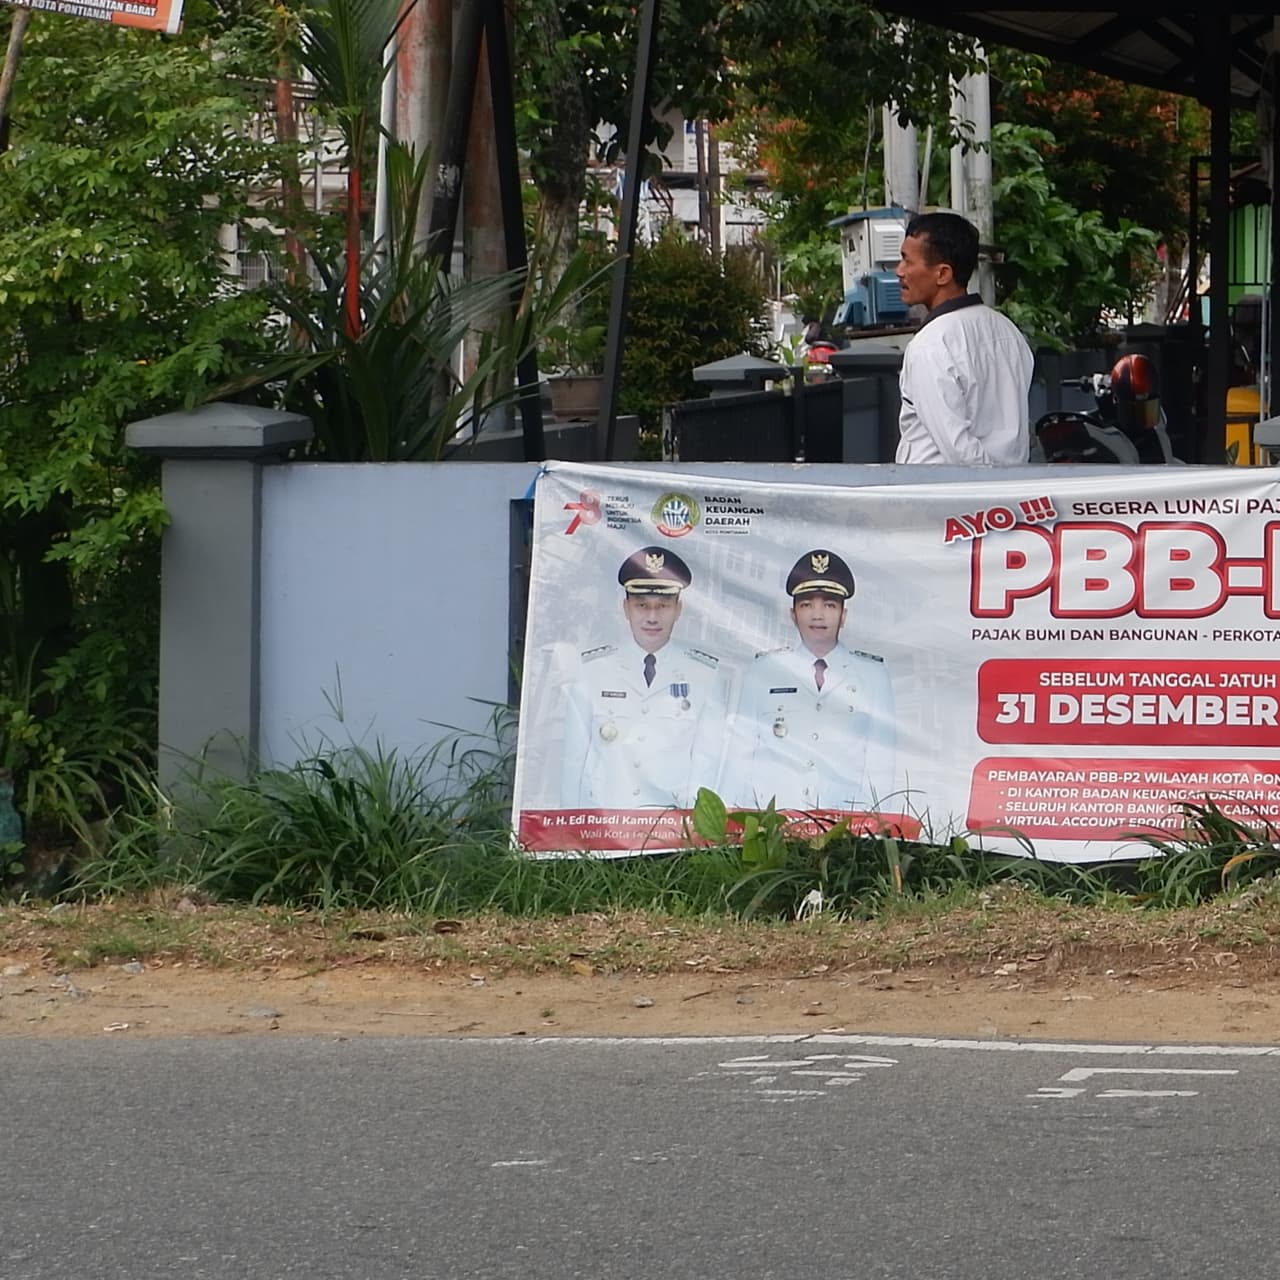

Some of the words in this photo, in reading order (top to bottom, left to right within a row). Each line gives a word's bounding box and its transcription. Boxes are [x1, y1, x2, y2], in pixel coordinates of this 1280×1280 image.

[125, 3, 157, 18] BARAT
[1072, 500, 1158, 515] SEGERA
[1163, 498, 1239, 514] LUNASI
[943, 505, 1014, 546] AYO
[971, 628, 1021, 640] PAJAK
[1025, 629, 1065, 640] BUMI
[1070, 629, 1104, 640] DAN
[1109, 629, 1197, 641] BANGUNAN
[1039, 672, 1124, 686] SEBELUM
[1128, 672, 1215, 687] TANGGAL
[1219, 673, 1275, 688] JATUH
[995, 693, 1035, 724] 31
[1048, 693, 1278, 726] DESEMBER
[988, 770, 1085, 783] PEMBAYARAN
[1089, 771, 1140, 783] PBB-P2
[1144, 772, 1208, 786] WILAYAH
[1212, 772, 1249, 784] KOTA
